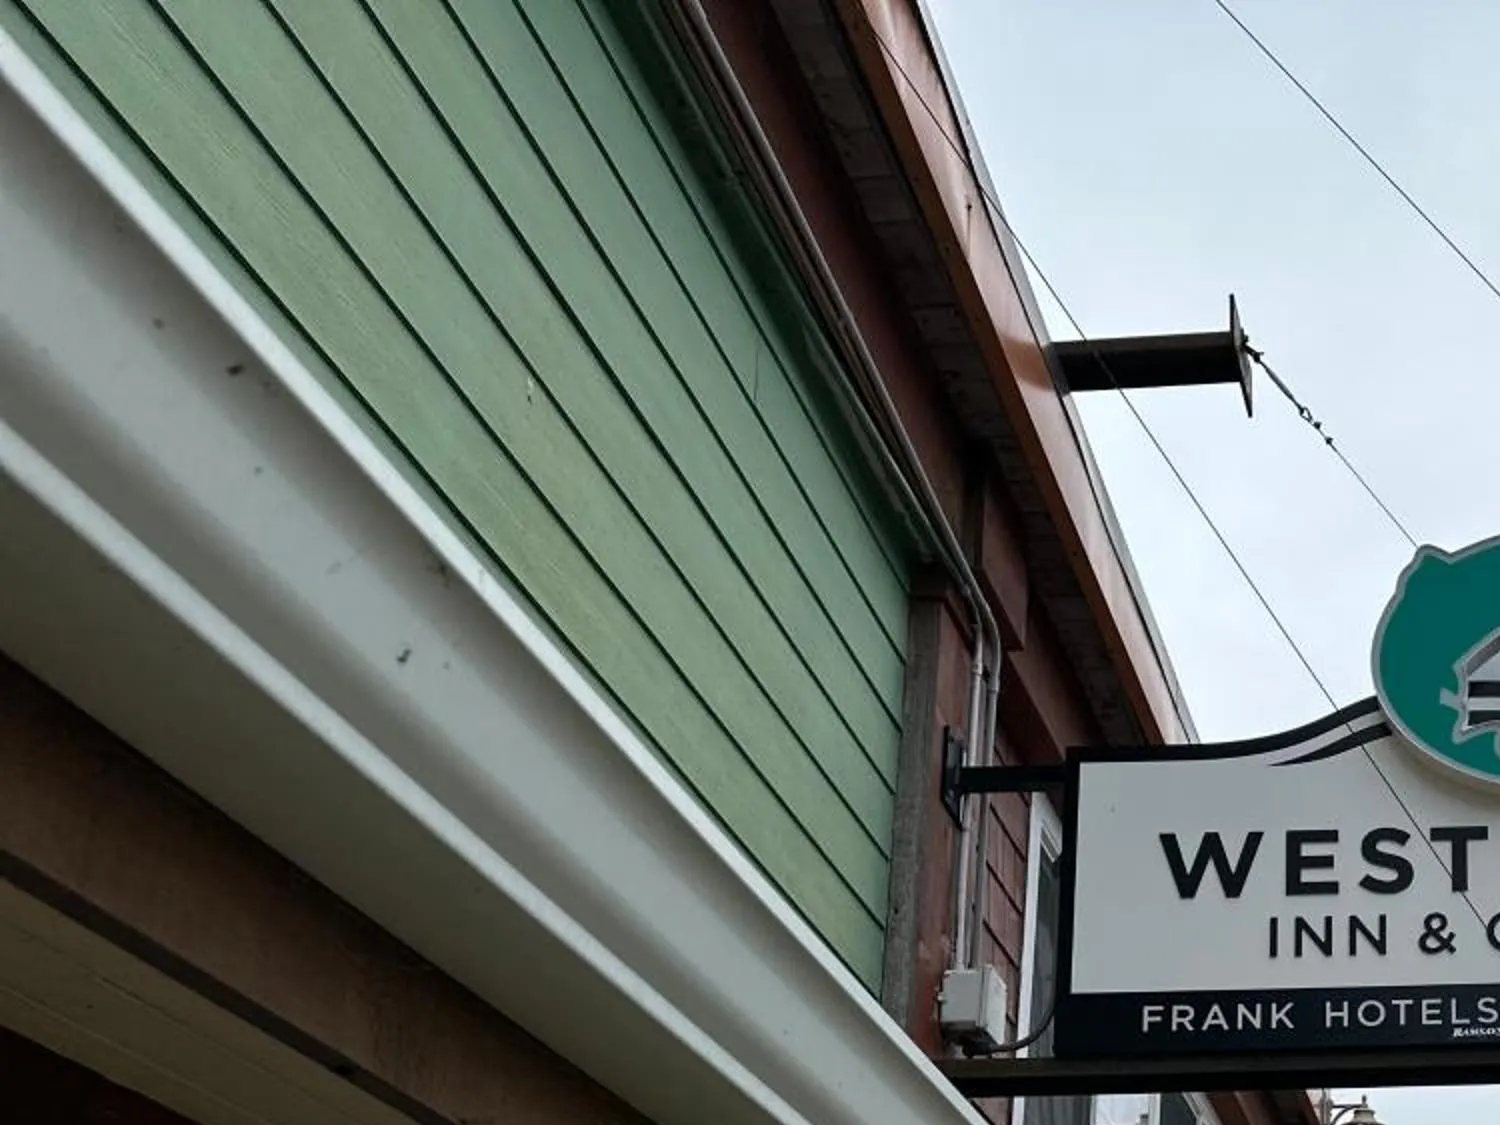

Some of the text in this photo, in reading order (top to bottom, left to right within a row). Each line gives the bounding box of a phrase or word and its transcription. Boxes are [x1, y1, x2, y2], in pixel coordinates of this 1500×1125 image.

[1269, 913, 1388, 959] INN
[1418, 912, 1458, 956] &
[1142, 1002, 1294, 1033] FRANK
[1325, 997, 1499, 1028] HOTELS
